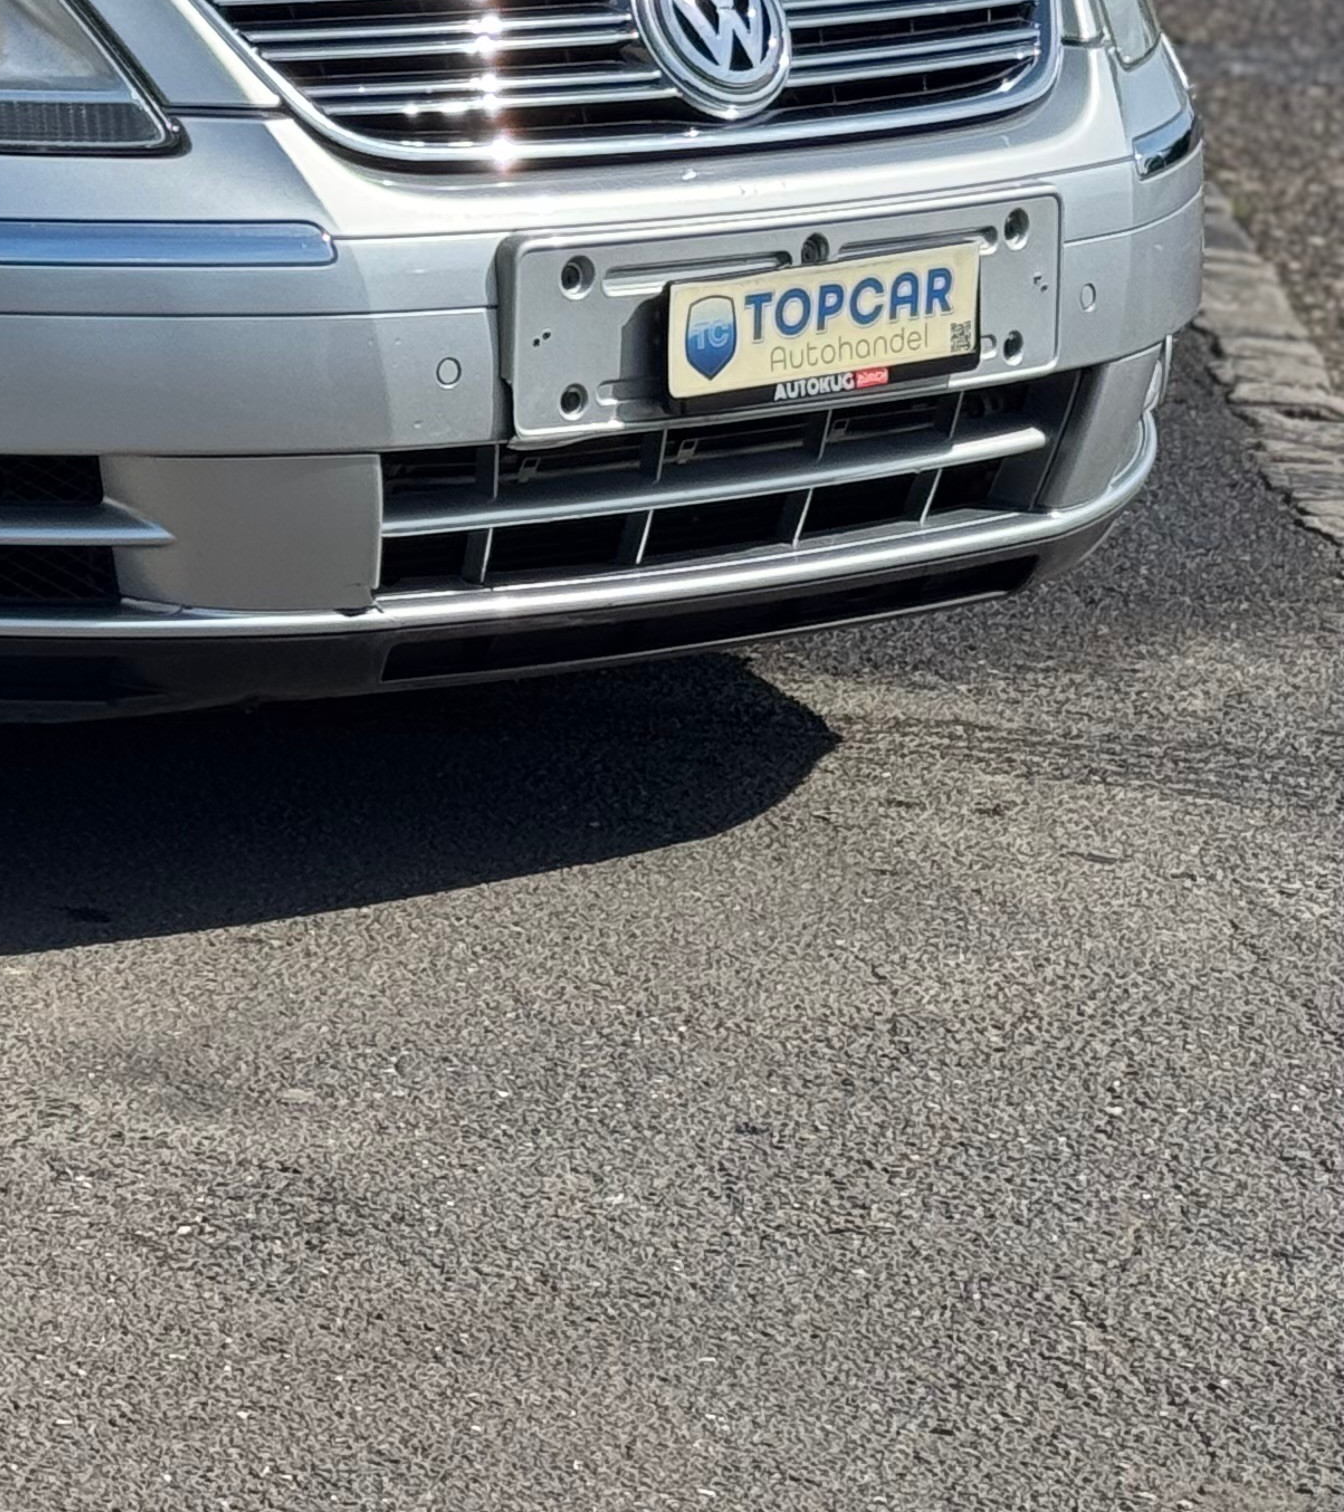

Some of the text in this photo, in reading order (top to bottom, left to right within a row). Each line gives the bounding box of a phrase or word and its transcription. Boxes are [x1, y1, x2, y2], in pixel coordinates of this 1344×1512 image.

[744, 267, 954, 344] TOPCAR
[691, 320, 732, 350] TC
[770, 323, 929, 373] Autohandel
